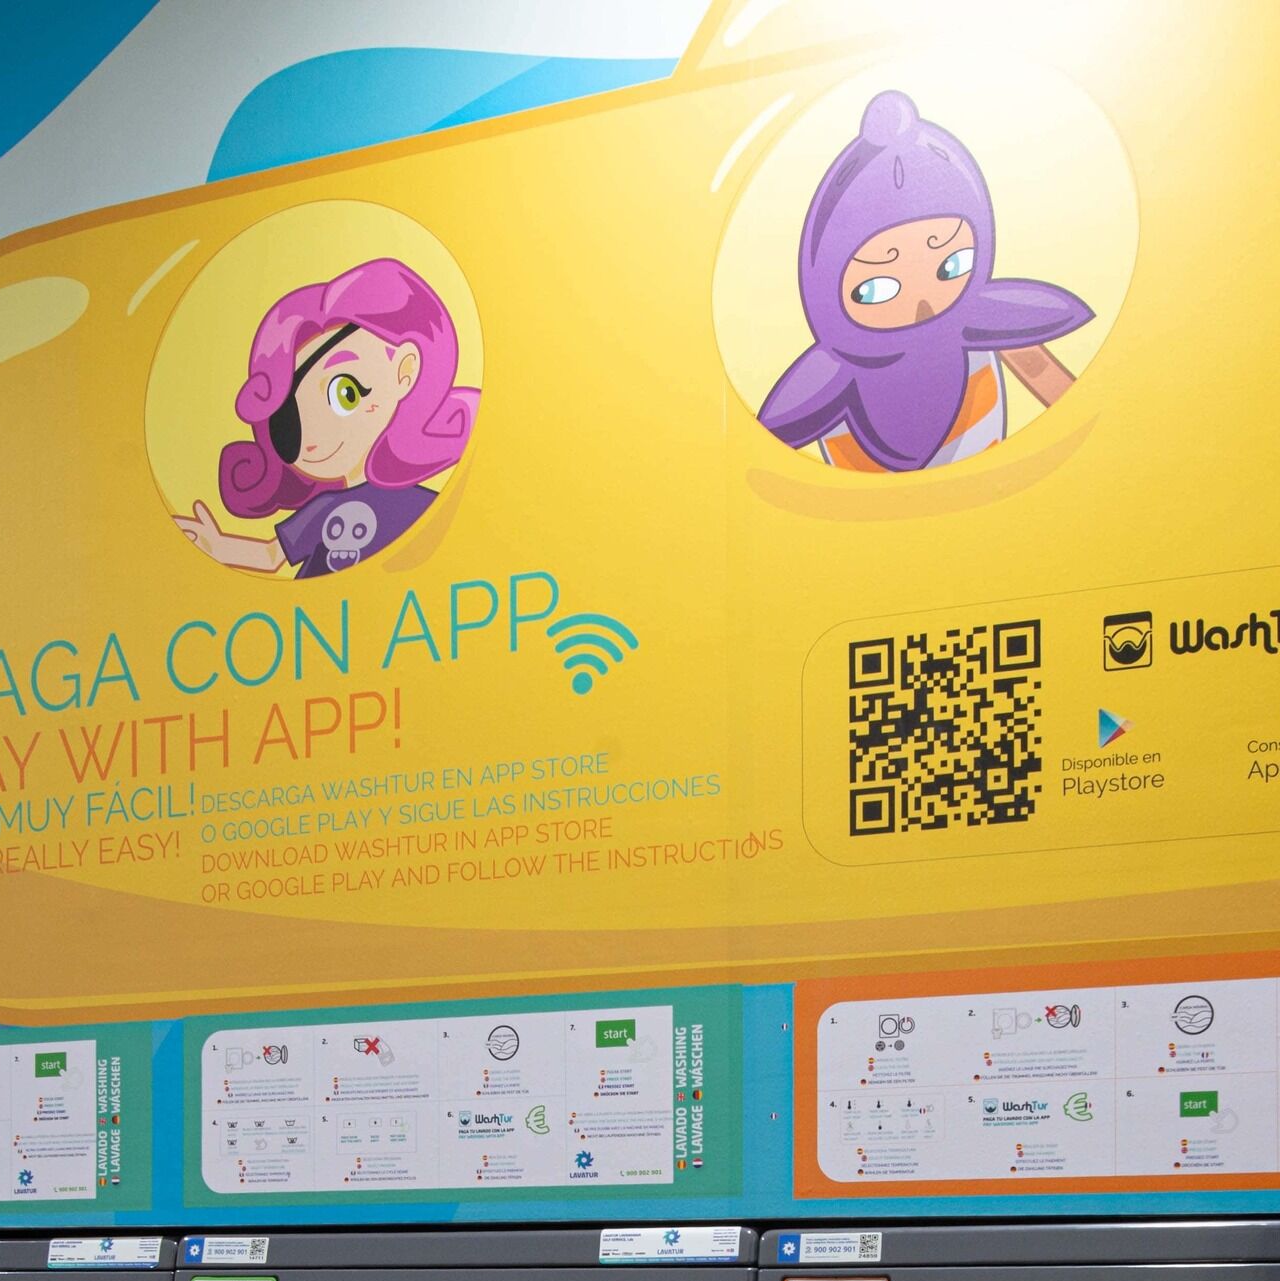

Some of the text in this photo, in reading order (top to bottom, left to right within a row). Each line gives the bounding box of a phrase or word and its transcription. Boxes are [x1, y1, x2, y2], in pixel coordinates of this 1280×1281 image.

[166, 600, 350, 695] CON
[381, 570, 560, 671] APP
[58, 708, 230, 784] WITH
[252, 687, 403, 766] APP!
[201, 752, 609, 814] DESCARGA WASHTUR EN APP STORE
[1062, 752, 1161, 773] Disponible en
[87, 780, 195, 827] FÁCIL!
[1063, 773, 1165, 798] Playstore
[201, 774, 720, 843] O GOOGLE PLAY Y SIGUE LAS INSTRUCCIONES
[99, 830, 181, 865] EASY!
[202, 817, 613, 874] DOWNLOAD WASHTUR IN APP STORE
[202, 829, 783, 903] OR GOOGLE PLAY AND FOLLOW THE INSTRUCTIONS
[603, 1029, 628, 1039] start
[41, 1061, 61, 1070] start
[675, 1027, 687, 1158] LAVADO WASHING
[1002, 1100, 1049, 1114] WashTur
[1184, 1099, 1207, 1110] start
[98, 1059, 108, 1176] LAVADO WASHING
[475, 1114, 513, 1126] WashTur
[691, 1105, 703, 1154] LAVAGE
[111, 1129, 120, 1172] LAVAGE
[569, 1171, 598, 1179] LAVATUR
